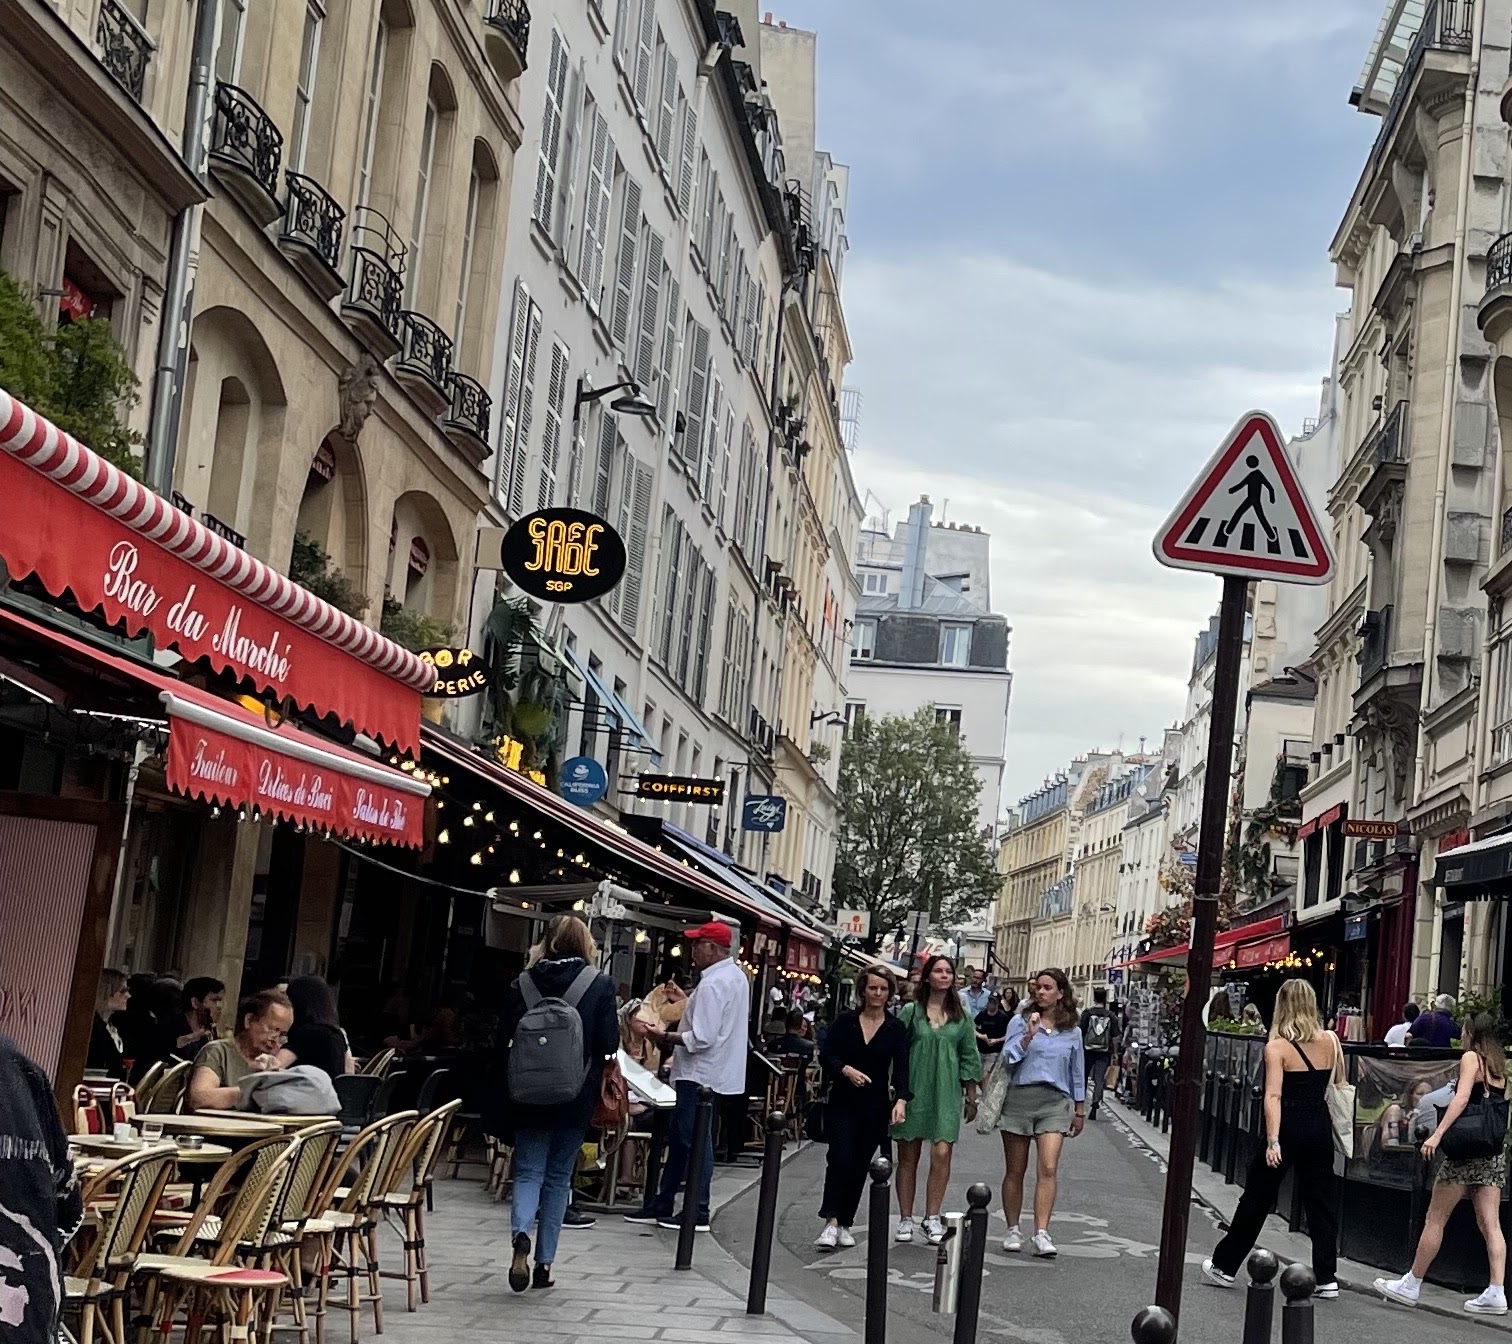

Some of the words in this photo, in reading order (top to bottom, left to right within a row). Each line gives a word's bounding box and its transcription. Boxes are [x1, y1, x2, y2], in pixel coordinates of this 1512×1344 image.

[545, 580, 574, 592] SGP
[103, 540, 163, 617] Bar
[166, 584, 209, 642] du
[212, 605, 292, 682] Marché
[1346, 823, 1394, 835] NICOLAS
